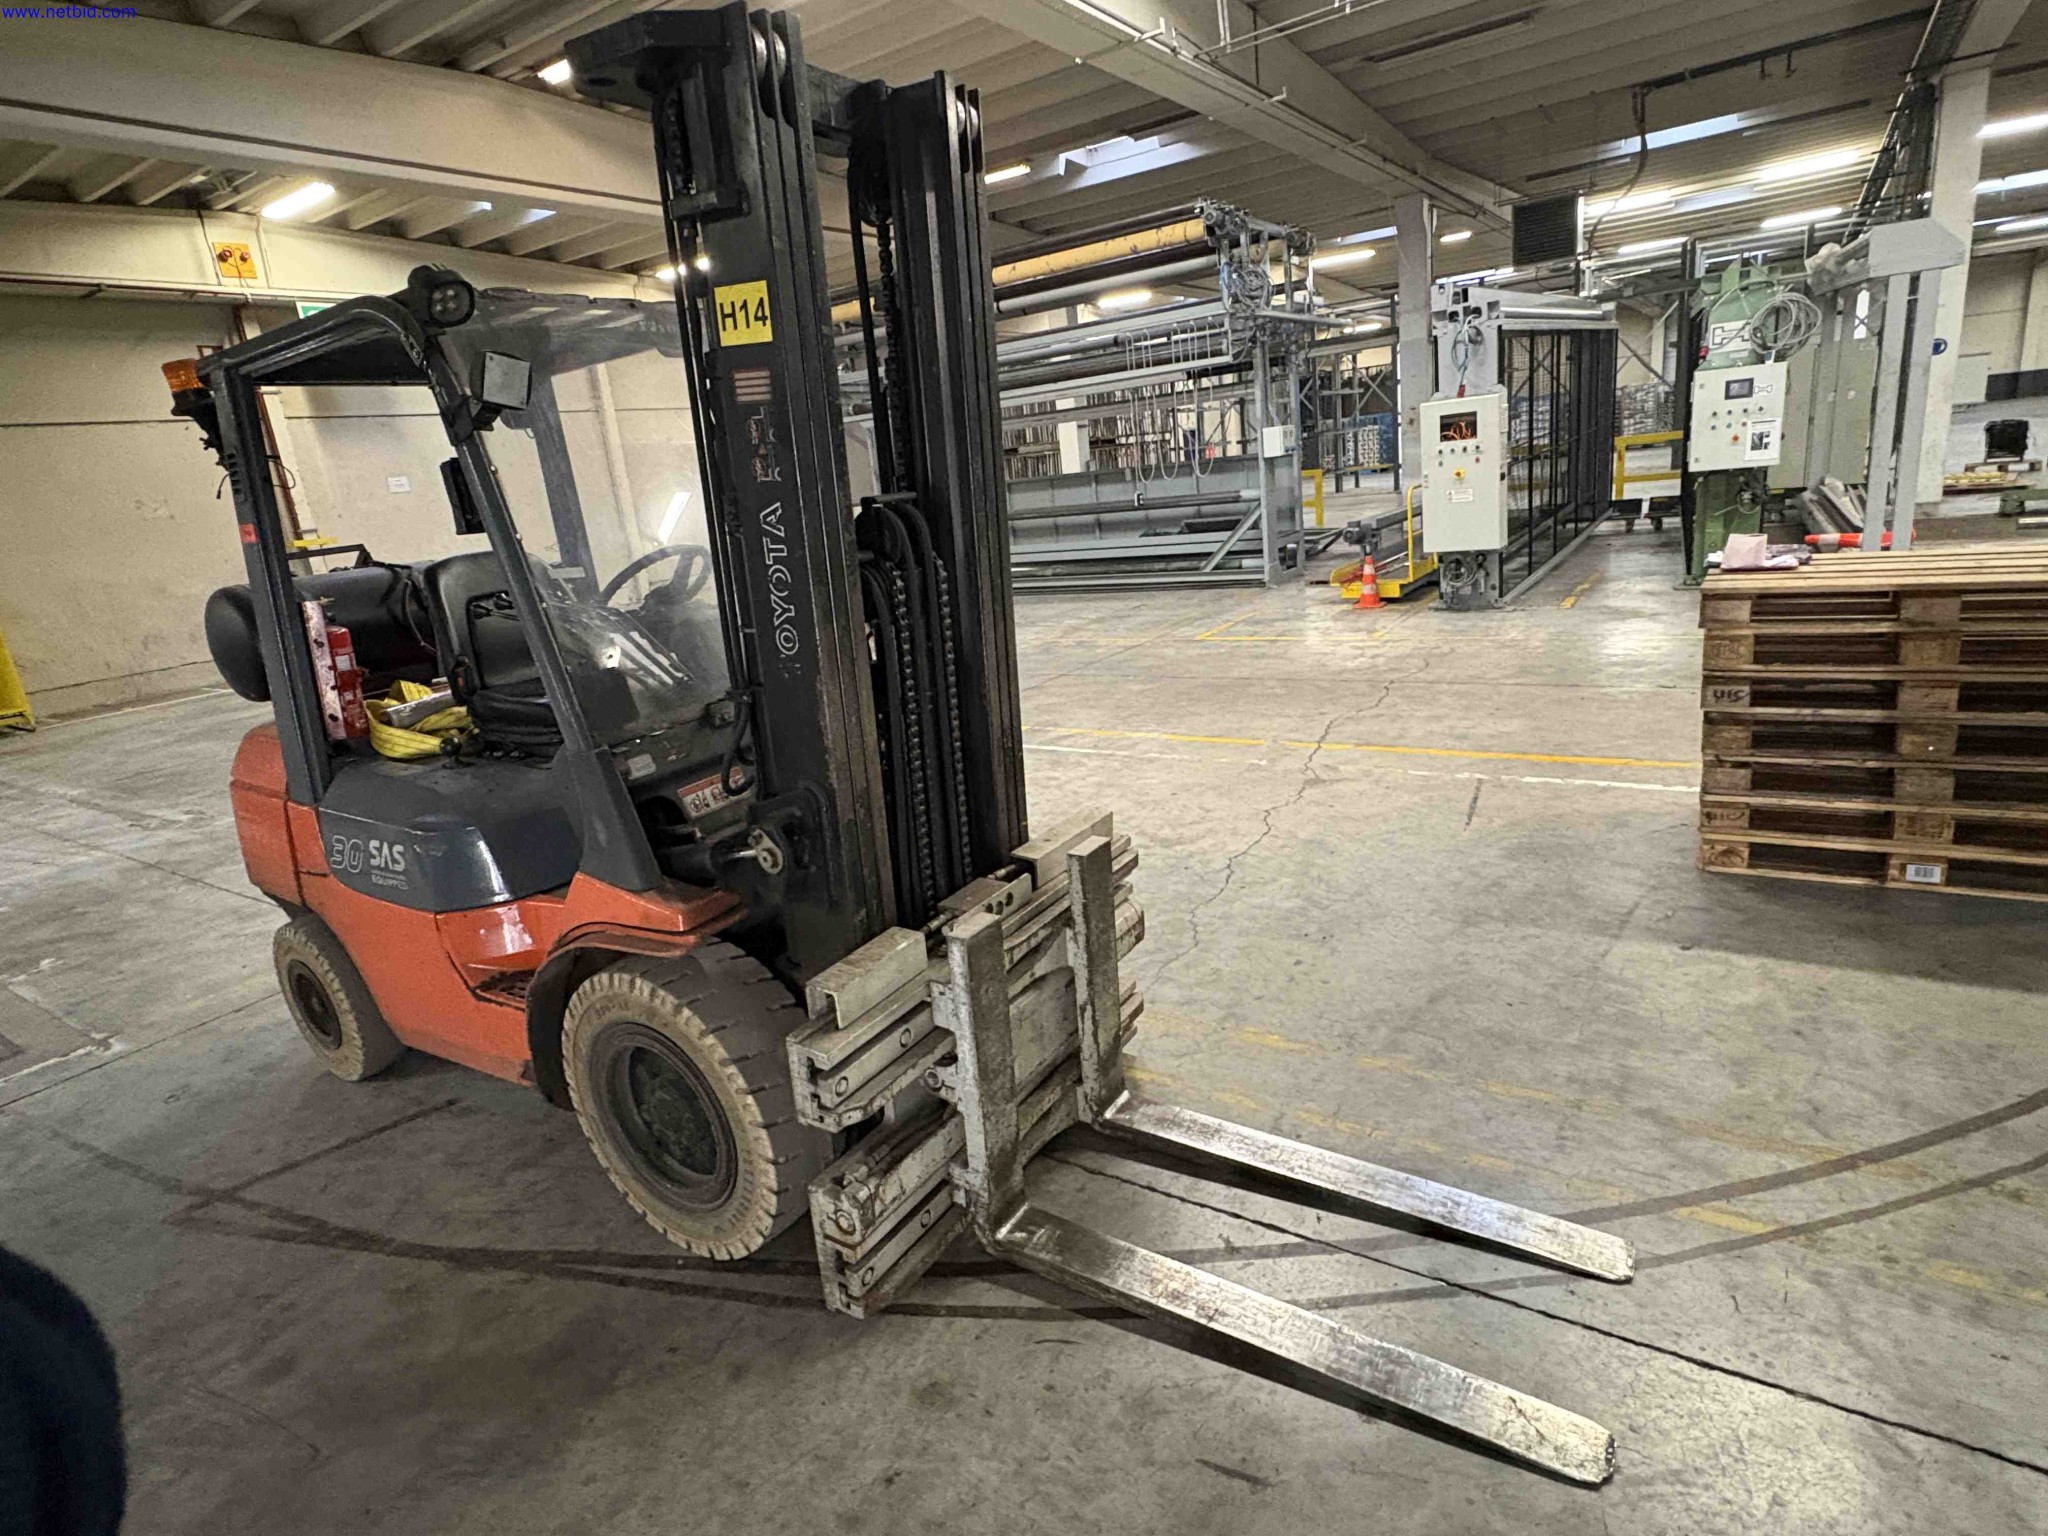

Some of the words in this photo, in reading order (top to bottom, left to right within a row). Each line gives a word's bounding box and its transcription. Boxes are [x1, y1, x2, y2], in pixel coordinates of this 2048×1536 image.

[719, 296, 769, 332] H14
[759, 501, 801, 678] OYOTA
[330, 835, 363, 873] 30
[369, 839, 406, 872] SAS
